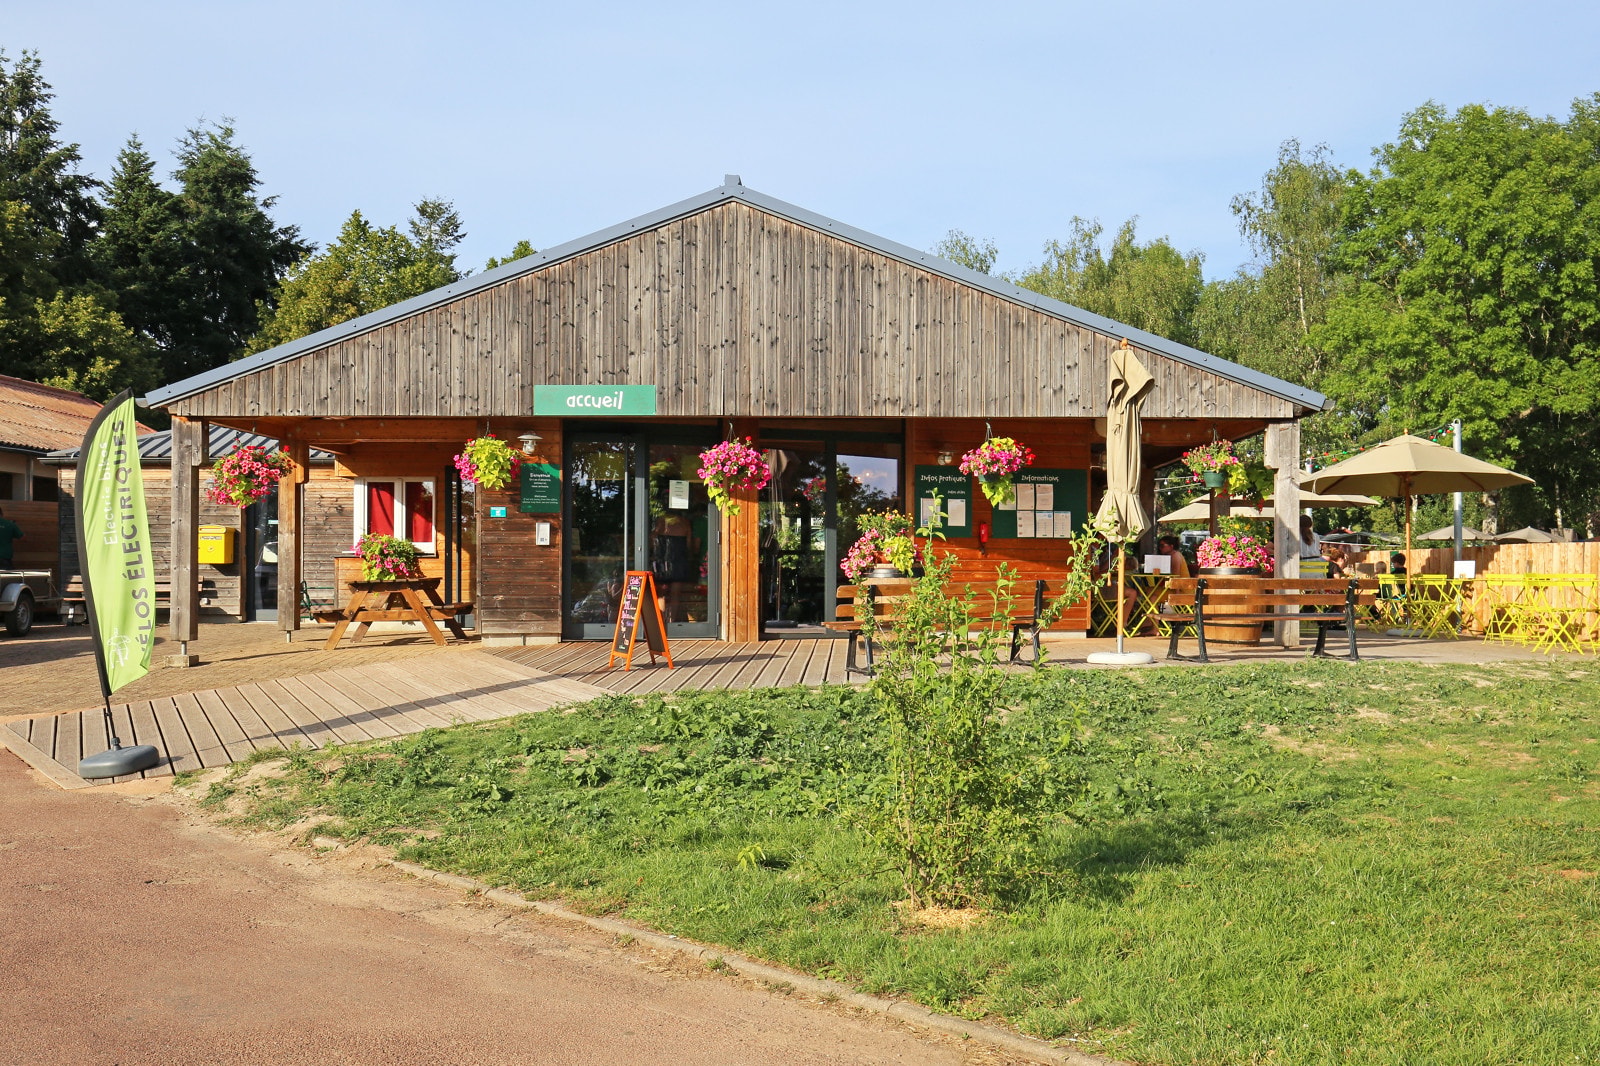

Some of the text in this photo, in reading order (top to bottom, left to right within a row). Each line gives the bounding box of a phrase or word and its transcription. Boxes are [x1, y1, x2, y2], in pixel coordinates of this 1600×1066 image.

[566, 391, 624, 410] accueil
[920, 474, 938, 483] Infos
[1021, 474, 1060, 483] Informations
[98, 442, 119, 545] Electric bikes
[111, 419, 152, 651] ÉLOS ÉLECTRIQUES
